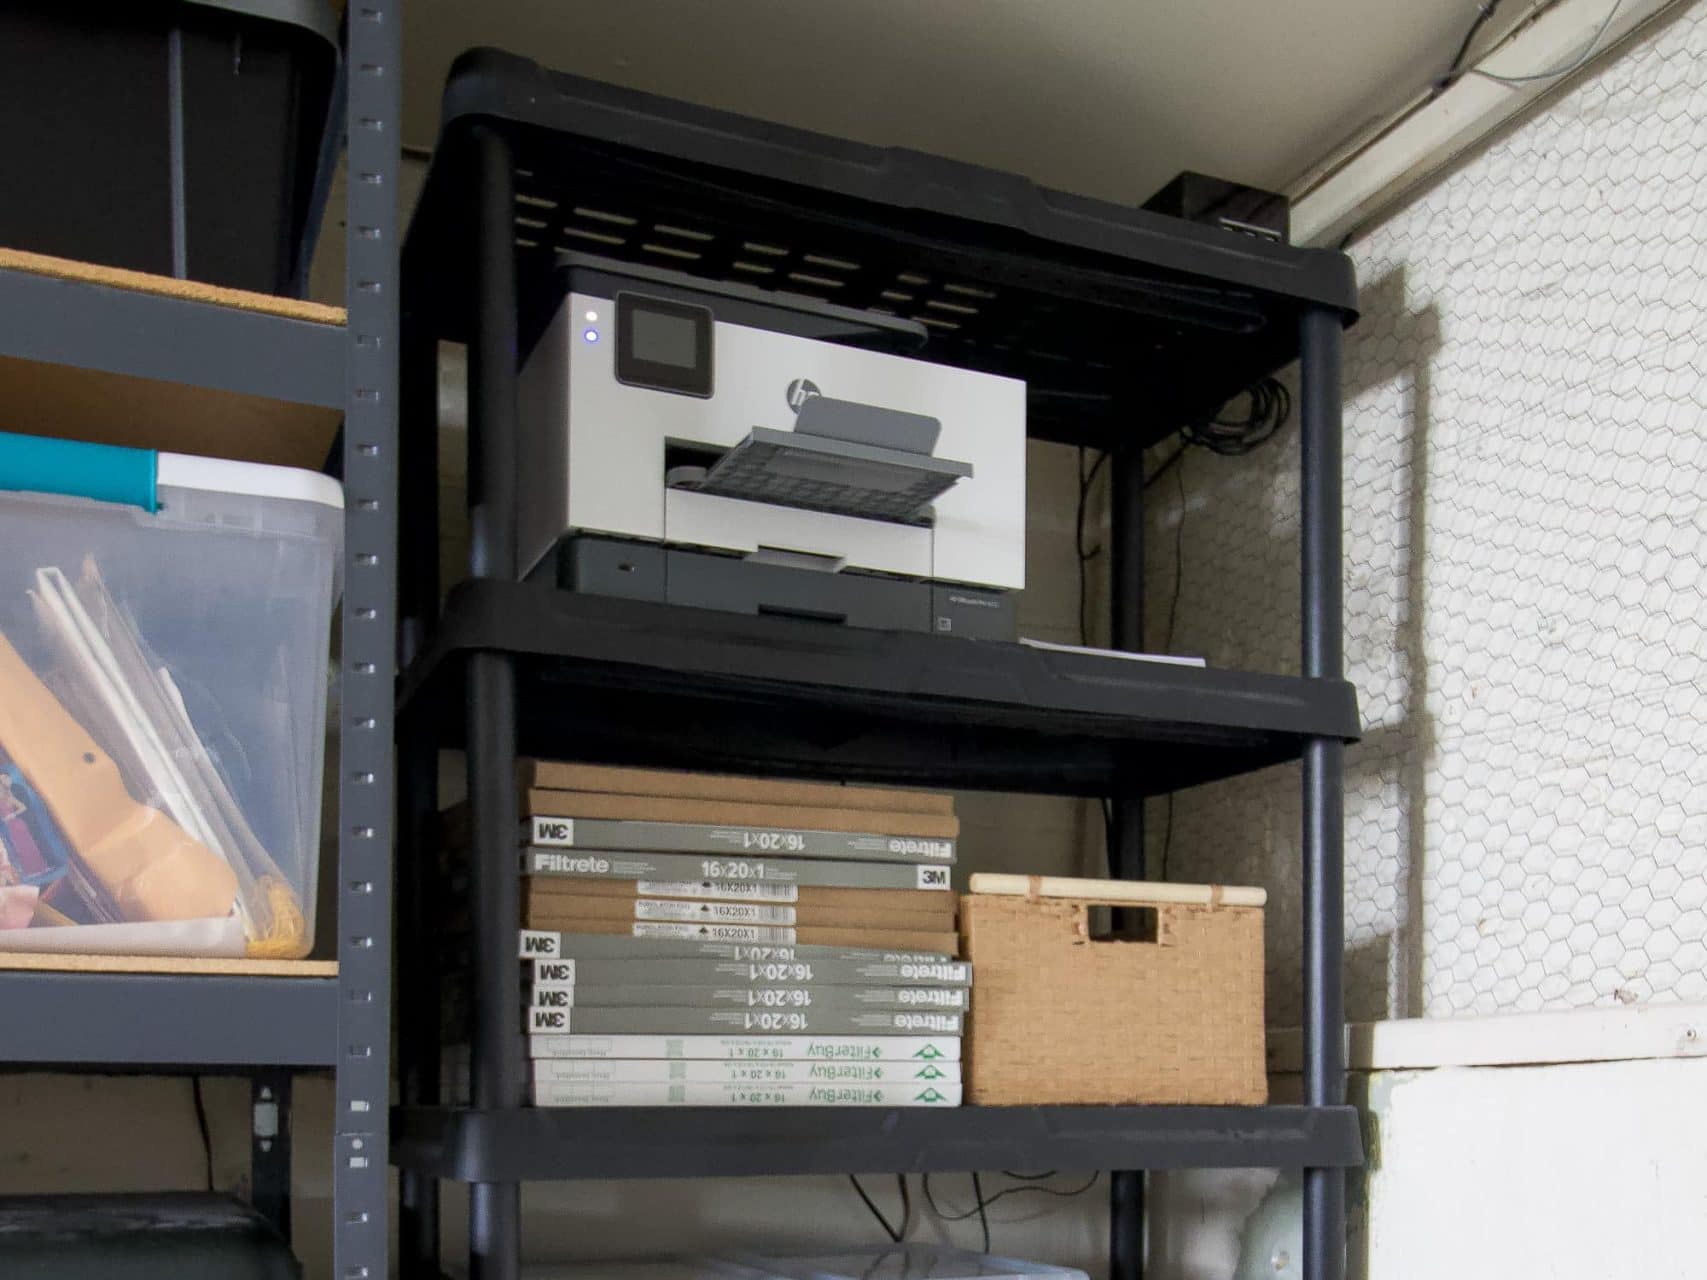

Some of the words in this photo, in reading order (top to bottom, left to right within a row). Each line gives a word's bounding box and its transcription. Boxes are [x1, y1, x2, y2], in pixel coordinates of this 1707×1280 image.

[539, 823, 568, 840] 3M
[743, 831, 806, 850] 16x20x1
[889, 839, 952, 858] Filtrete
[534, 853, 610, 873] Filtrete
[702, 860, 765, 880] 16x20x1
[922, 870, 947, 884] 3M
[714, 905, 756, 916] 16X20X1
[713, 927, 755, 939] 16X20X1
[525, 937, 555, 953] 3M
[540, 964, 570, 980] 3M
[750, 963, 814, 981] 16x20x1
[901, 963, 966, 981] Filtrete
[539, 991, 568, 1007] 3M
[747, 989, 811, 1007] 16x20x1
[898, 988, 963, 1007] Filtrete
[535, 1012, 565, 1028] 3M
[743, 1012, 808, 1030] 16x20x1
[894, 1012, 959, 1031] Filtrete
[808, 1042, 873, 1058] FilterBuy
[809, 1063, 874, 1079] FilterBuy
[809, 1086, 873, 1103] FilterBuy
